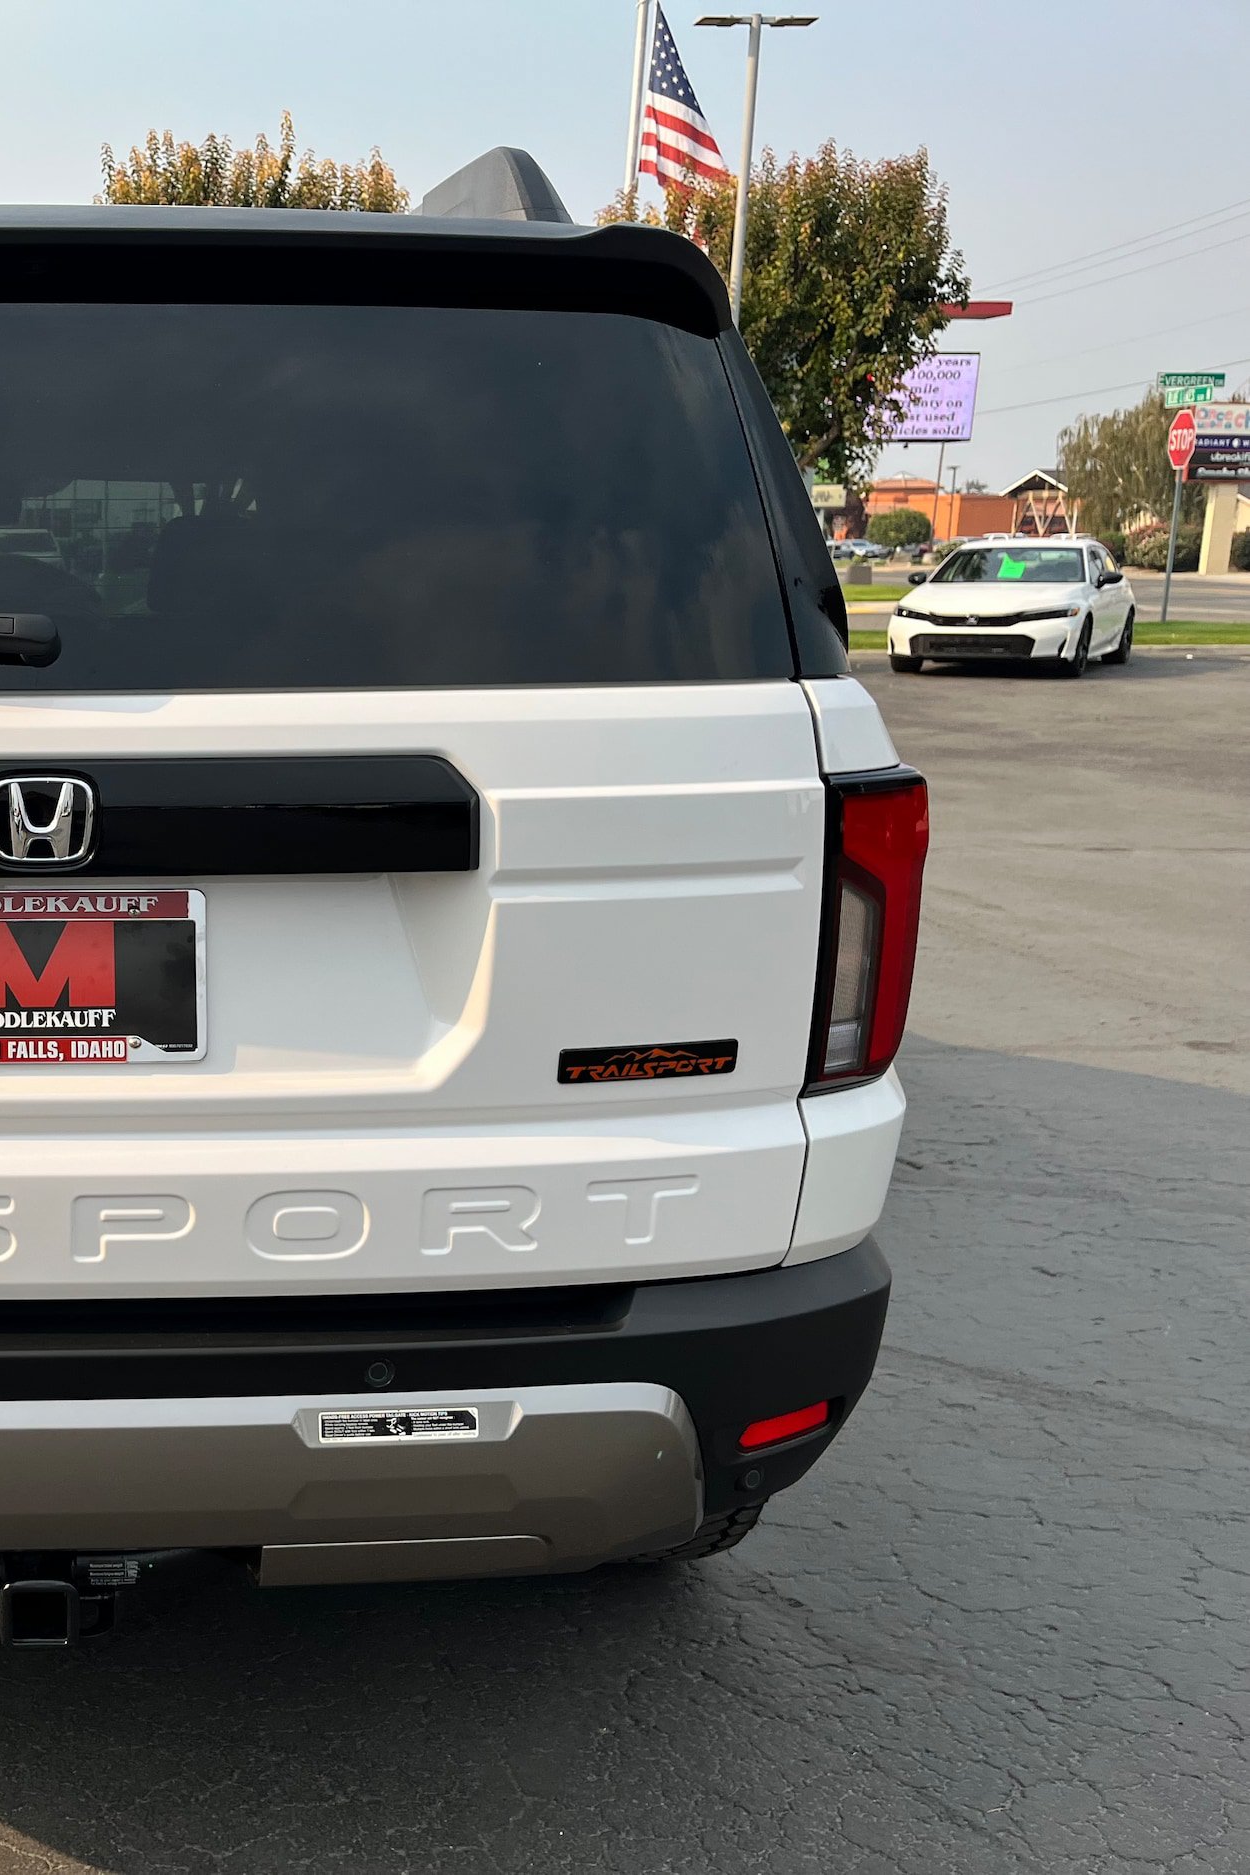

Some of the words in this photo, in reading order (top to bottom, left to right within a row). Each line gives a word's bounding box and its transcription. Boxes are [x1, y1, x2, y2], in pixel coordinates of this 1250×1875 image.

[910, 370, 961, 381] 100,000
[1159, 374, 1215, 386] EVERGREEN
[910, 384, 940, 393] mile
[946, 400, 963, 408] on
[924, 412, 956, 421] used
[1170, 429, 1193, 451] STOP
[7, 1040, 64, 1061] FALLS,
[71, 1039, 126, 1058] IDAHO
[565, 1056, 733, 1081] TRAILSPORT
